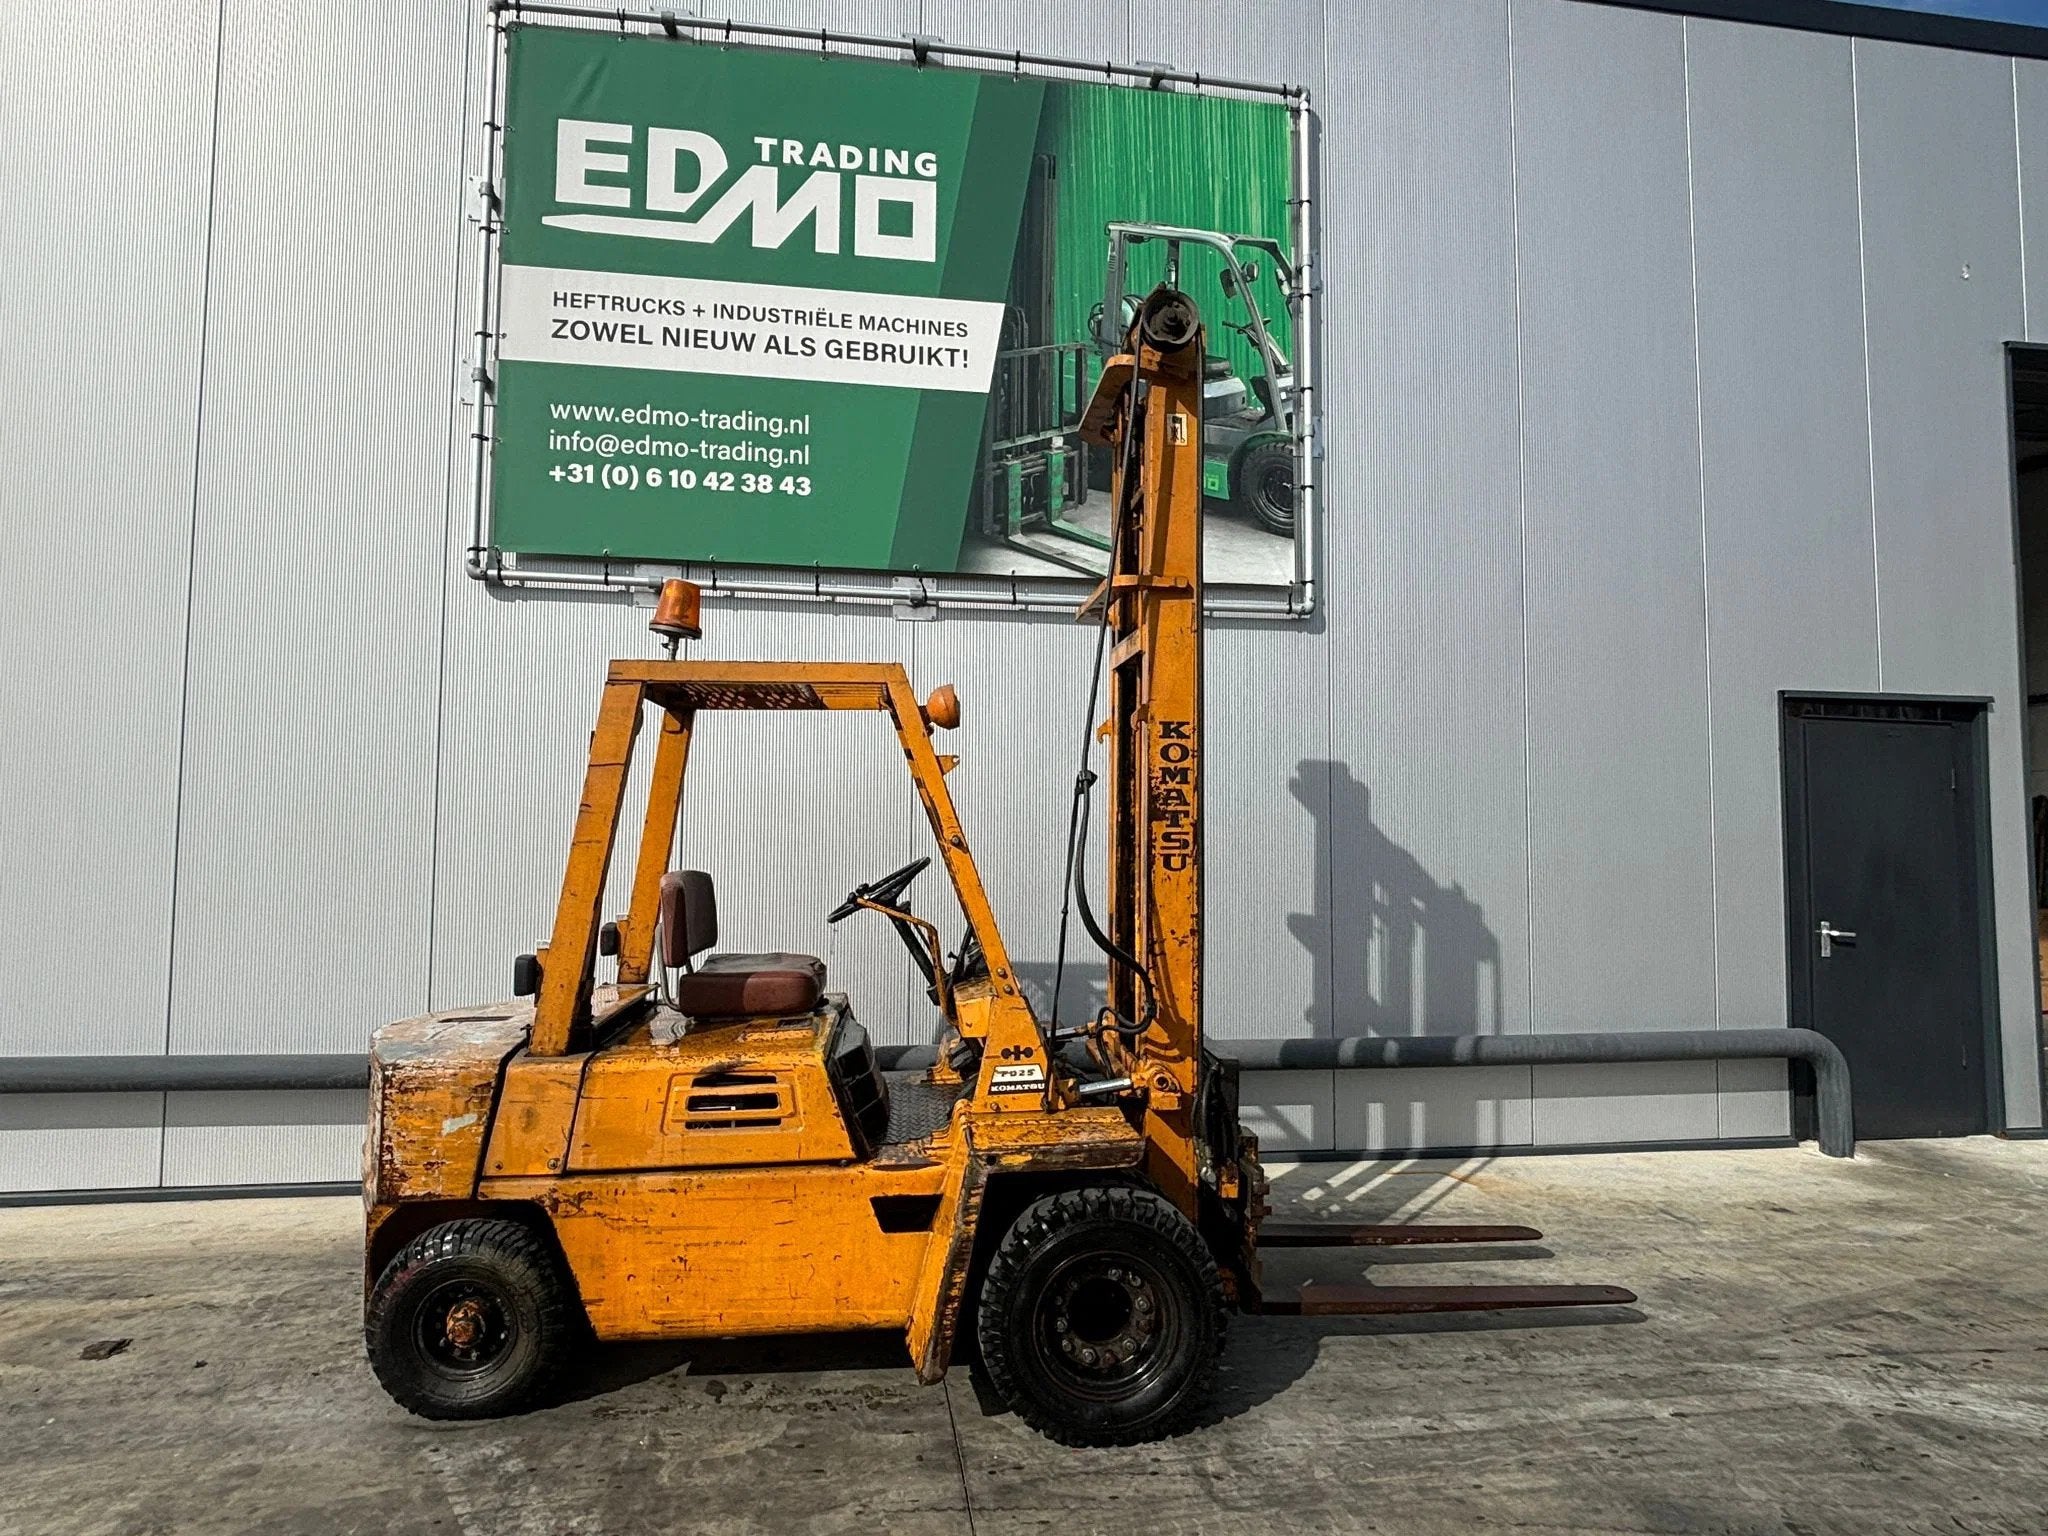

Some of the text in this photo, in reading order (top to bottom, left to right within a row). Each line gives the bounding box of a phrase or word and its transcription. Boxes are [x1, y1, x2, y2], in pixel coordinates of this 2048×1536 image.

[754, 137, 937, 177] TRADING
[542, 119, 937, 262] EDMO
[553, 291, 968, 338] HEFTRUCKS + INDUSTRIËLE MACHINES
[551, 318, 969, 369] ZOWEL NIEUW ALS GEBRUIKT!
[549, 403, 811, 437] www.edmo-trading.nl
[548, 428, 811, 469] info@edmo-trading.nl
[548, 463, 812, 496] +31 (0) 6 10 42 38 43
[1158, 720, 1191, 873] KOMATSU
[990, 1083, 1045, 1092] KOMATSU
